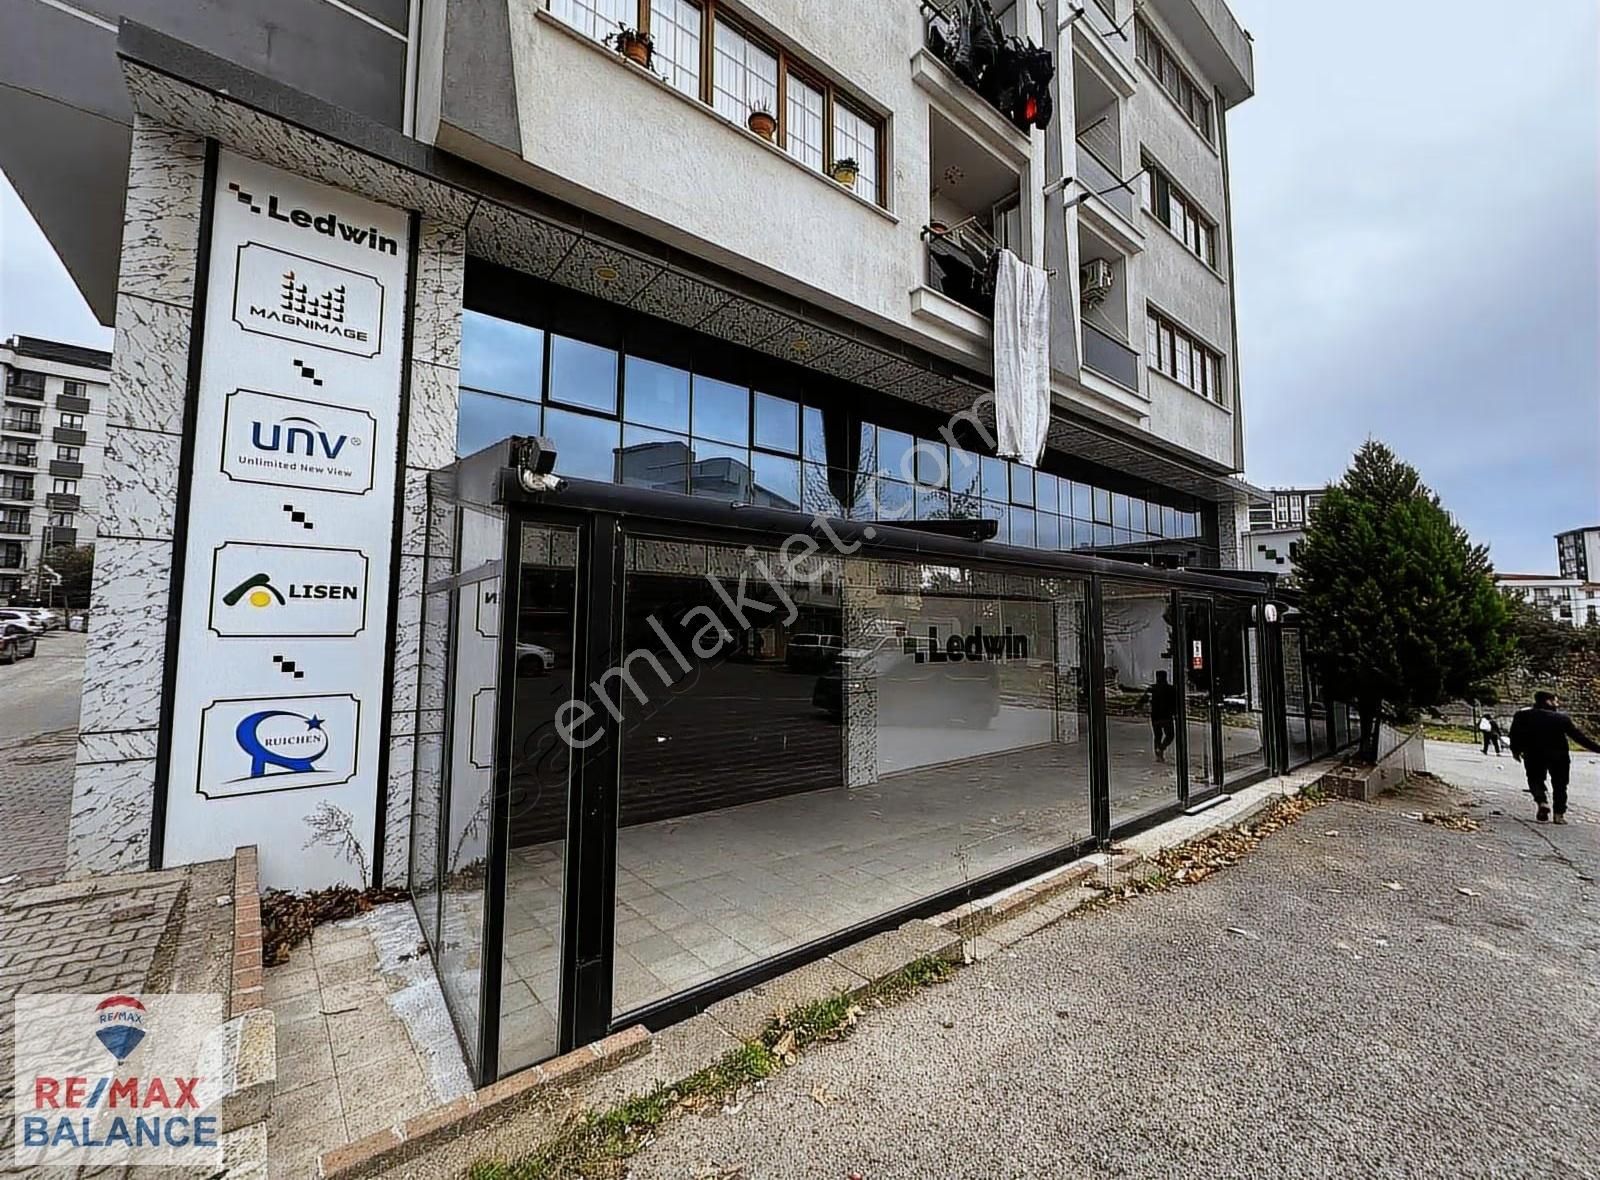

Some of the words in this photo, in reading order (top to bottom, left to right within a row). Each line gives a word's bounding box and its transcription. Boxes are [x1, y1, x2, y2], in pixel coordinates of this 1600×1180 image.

[268, 196, 398, 256] Ledwin
[250, 306, 368, 342] MAGNIMAGE
[239, 456, 297, 471] Unlimited
[300, 464, 324, 474] New
[327, 467, 352, 477] View
[929, 625, 1028, 663] Ledwin
[265, 734, 322, 747] RUICHEN
